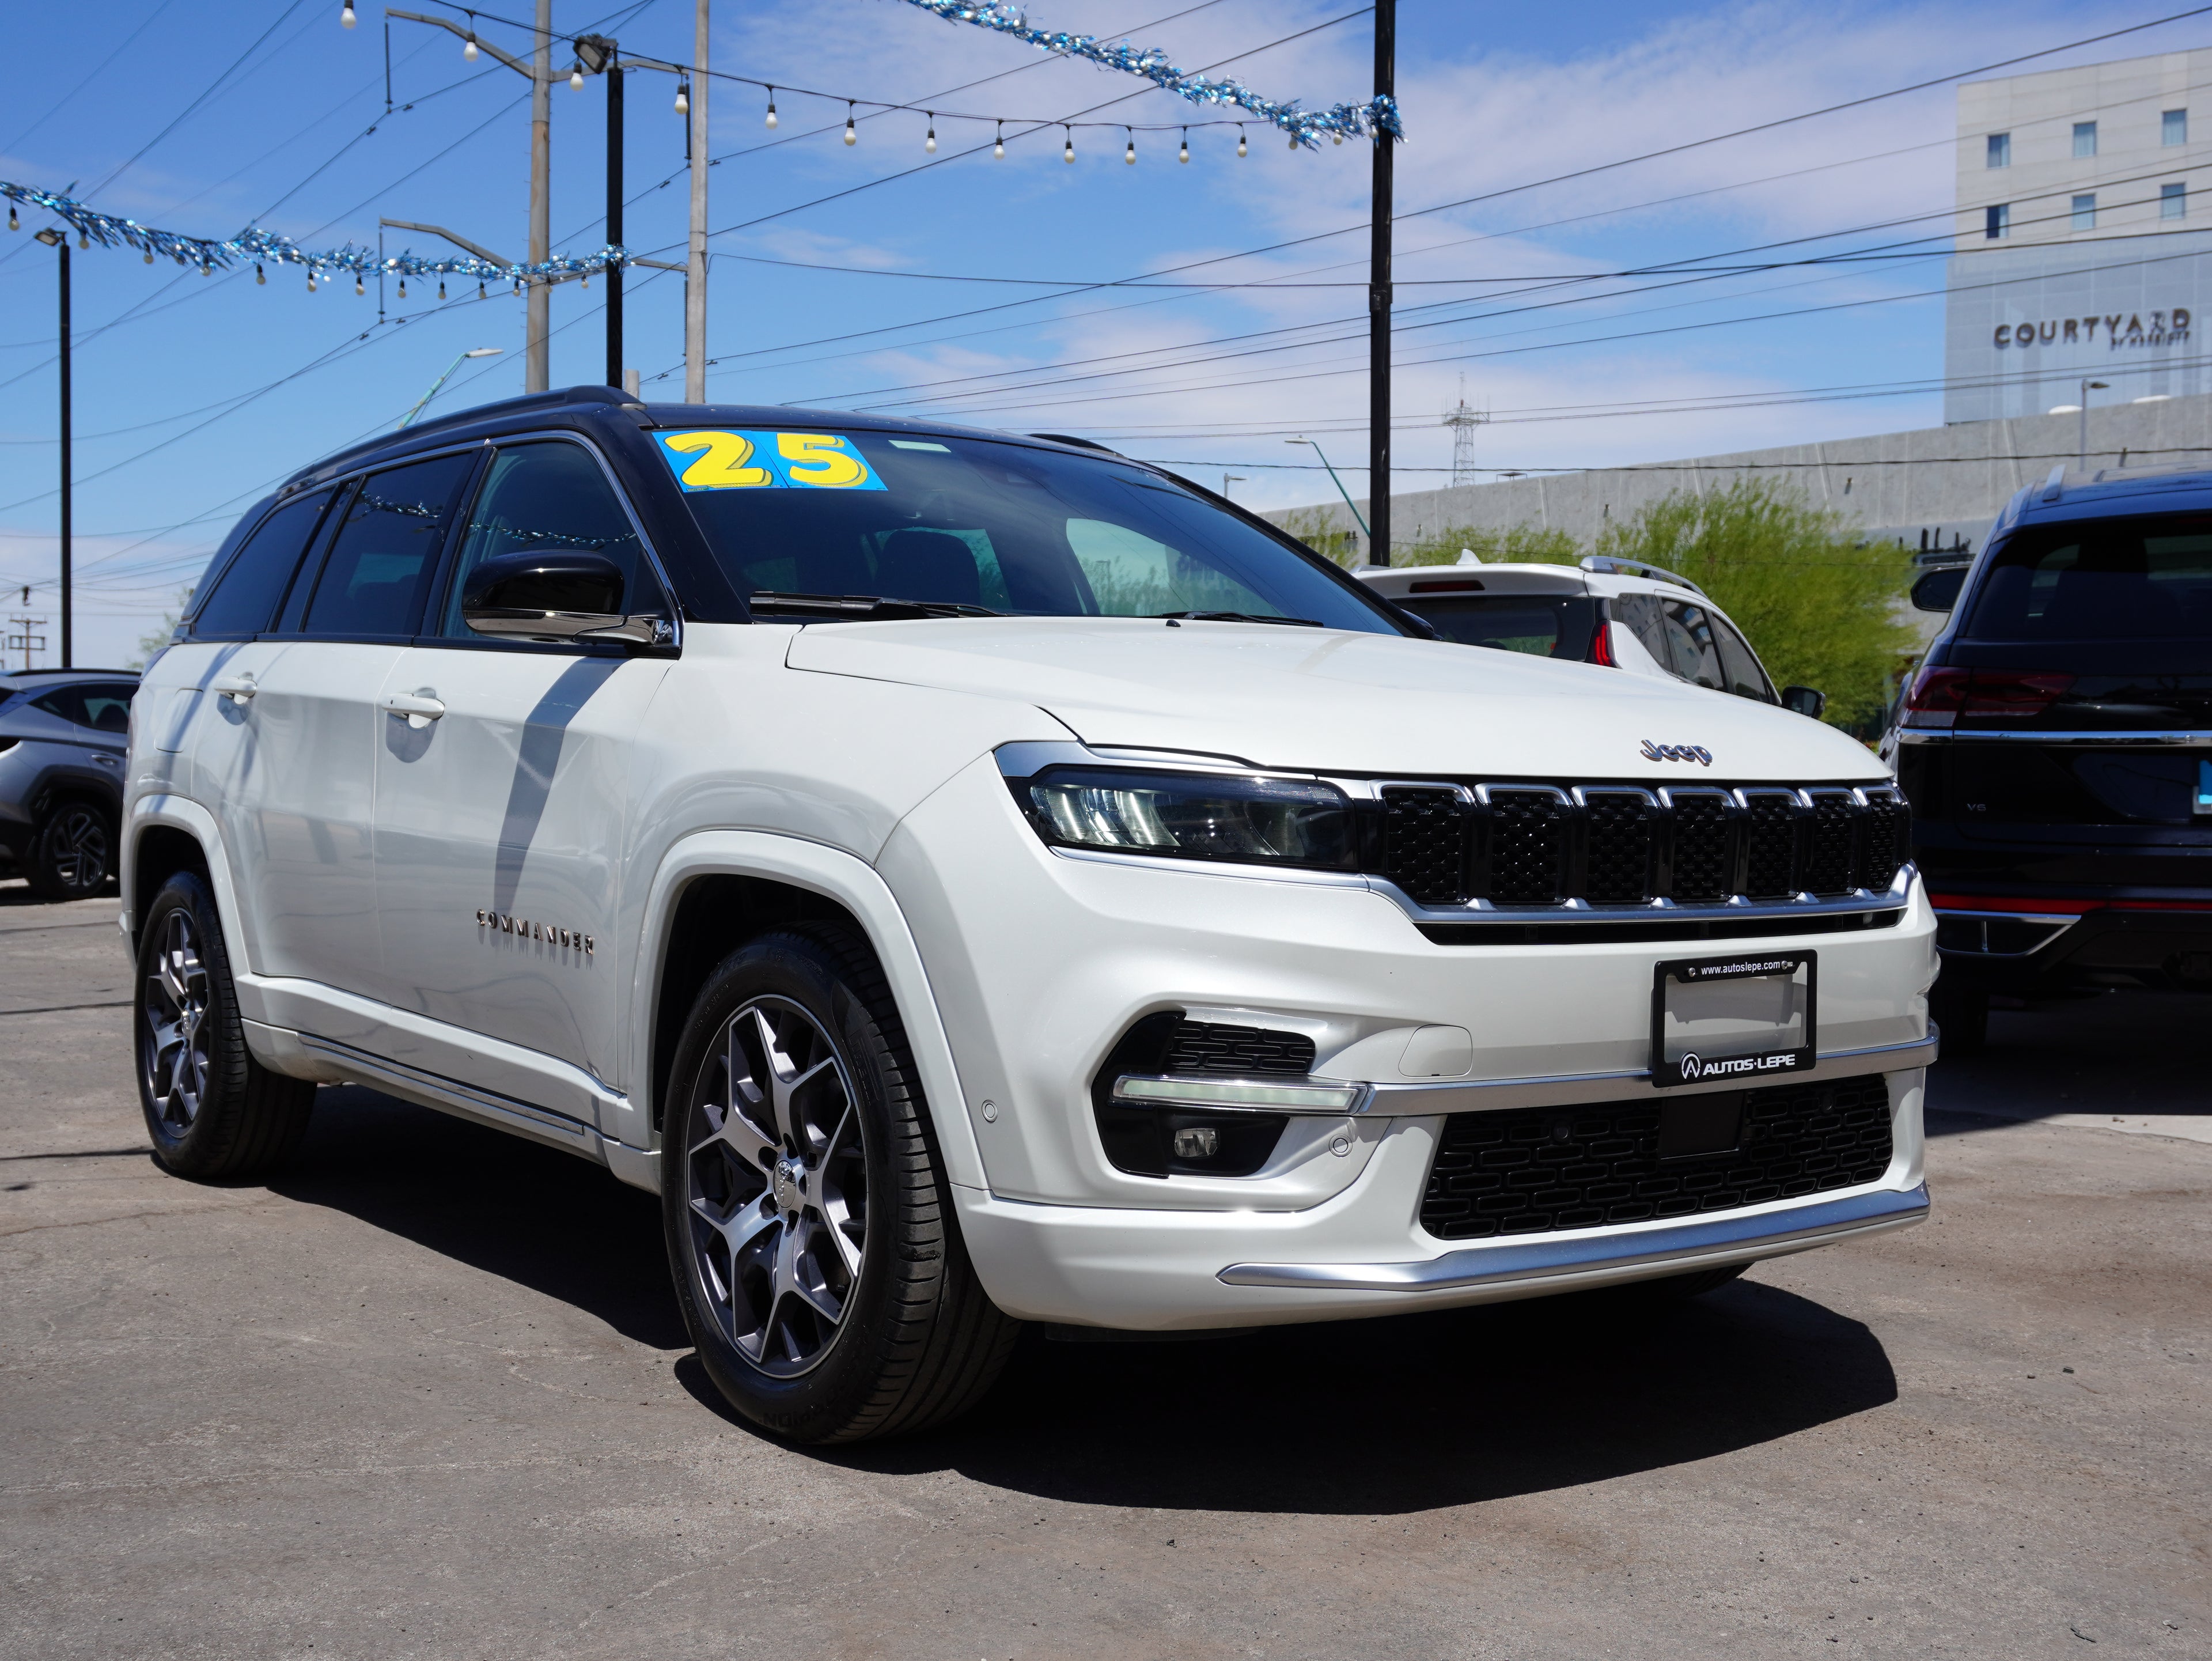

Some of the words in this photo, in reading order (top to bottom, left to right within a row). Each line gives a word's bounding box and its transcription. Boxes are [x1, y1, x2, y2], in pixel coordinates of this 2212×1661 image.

[664, 431, 868, 487] 25
[1640, 739, 1713, 767] Jeep
[476, 909, 596, 955] COMMANDER
[1701, 961, 1781, 975] www.autoslepe.com
